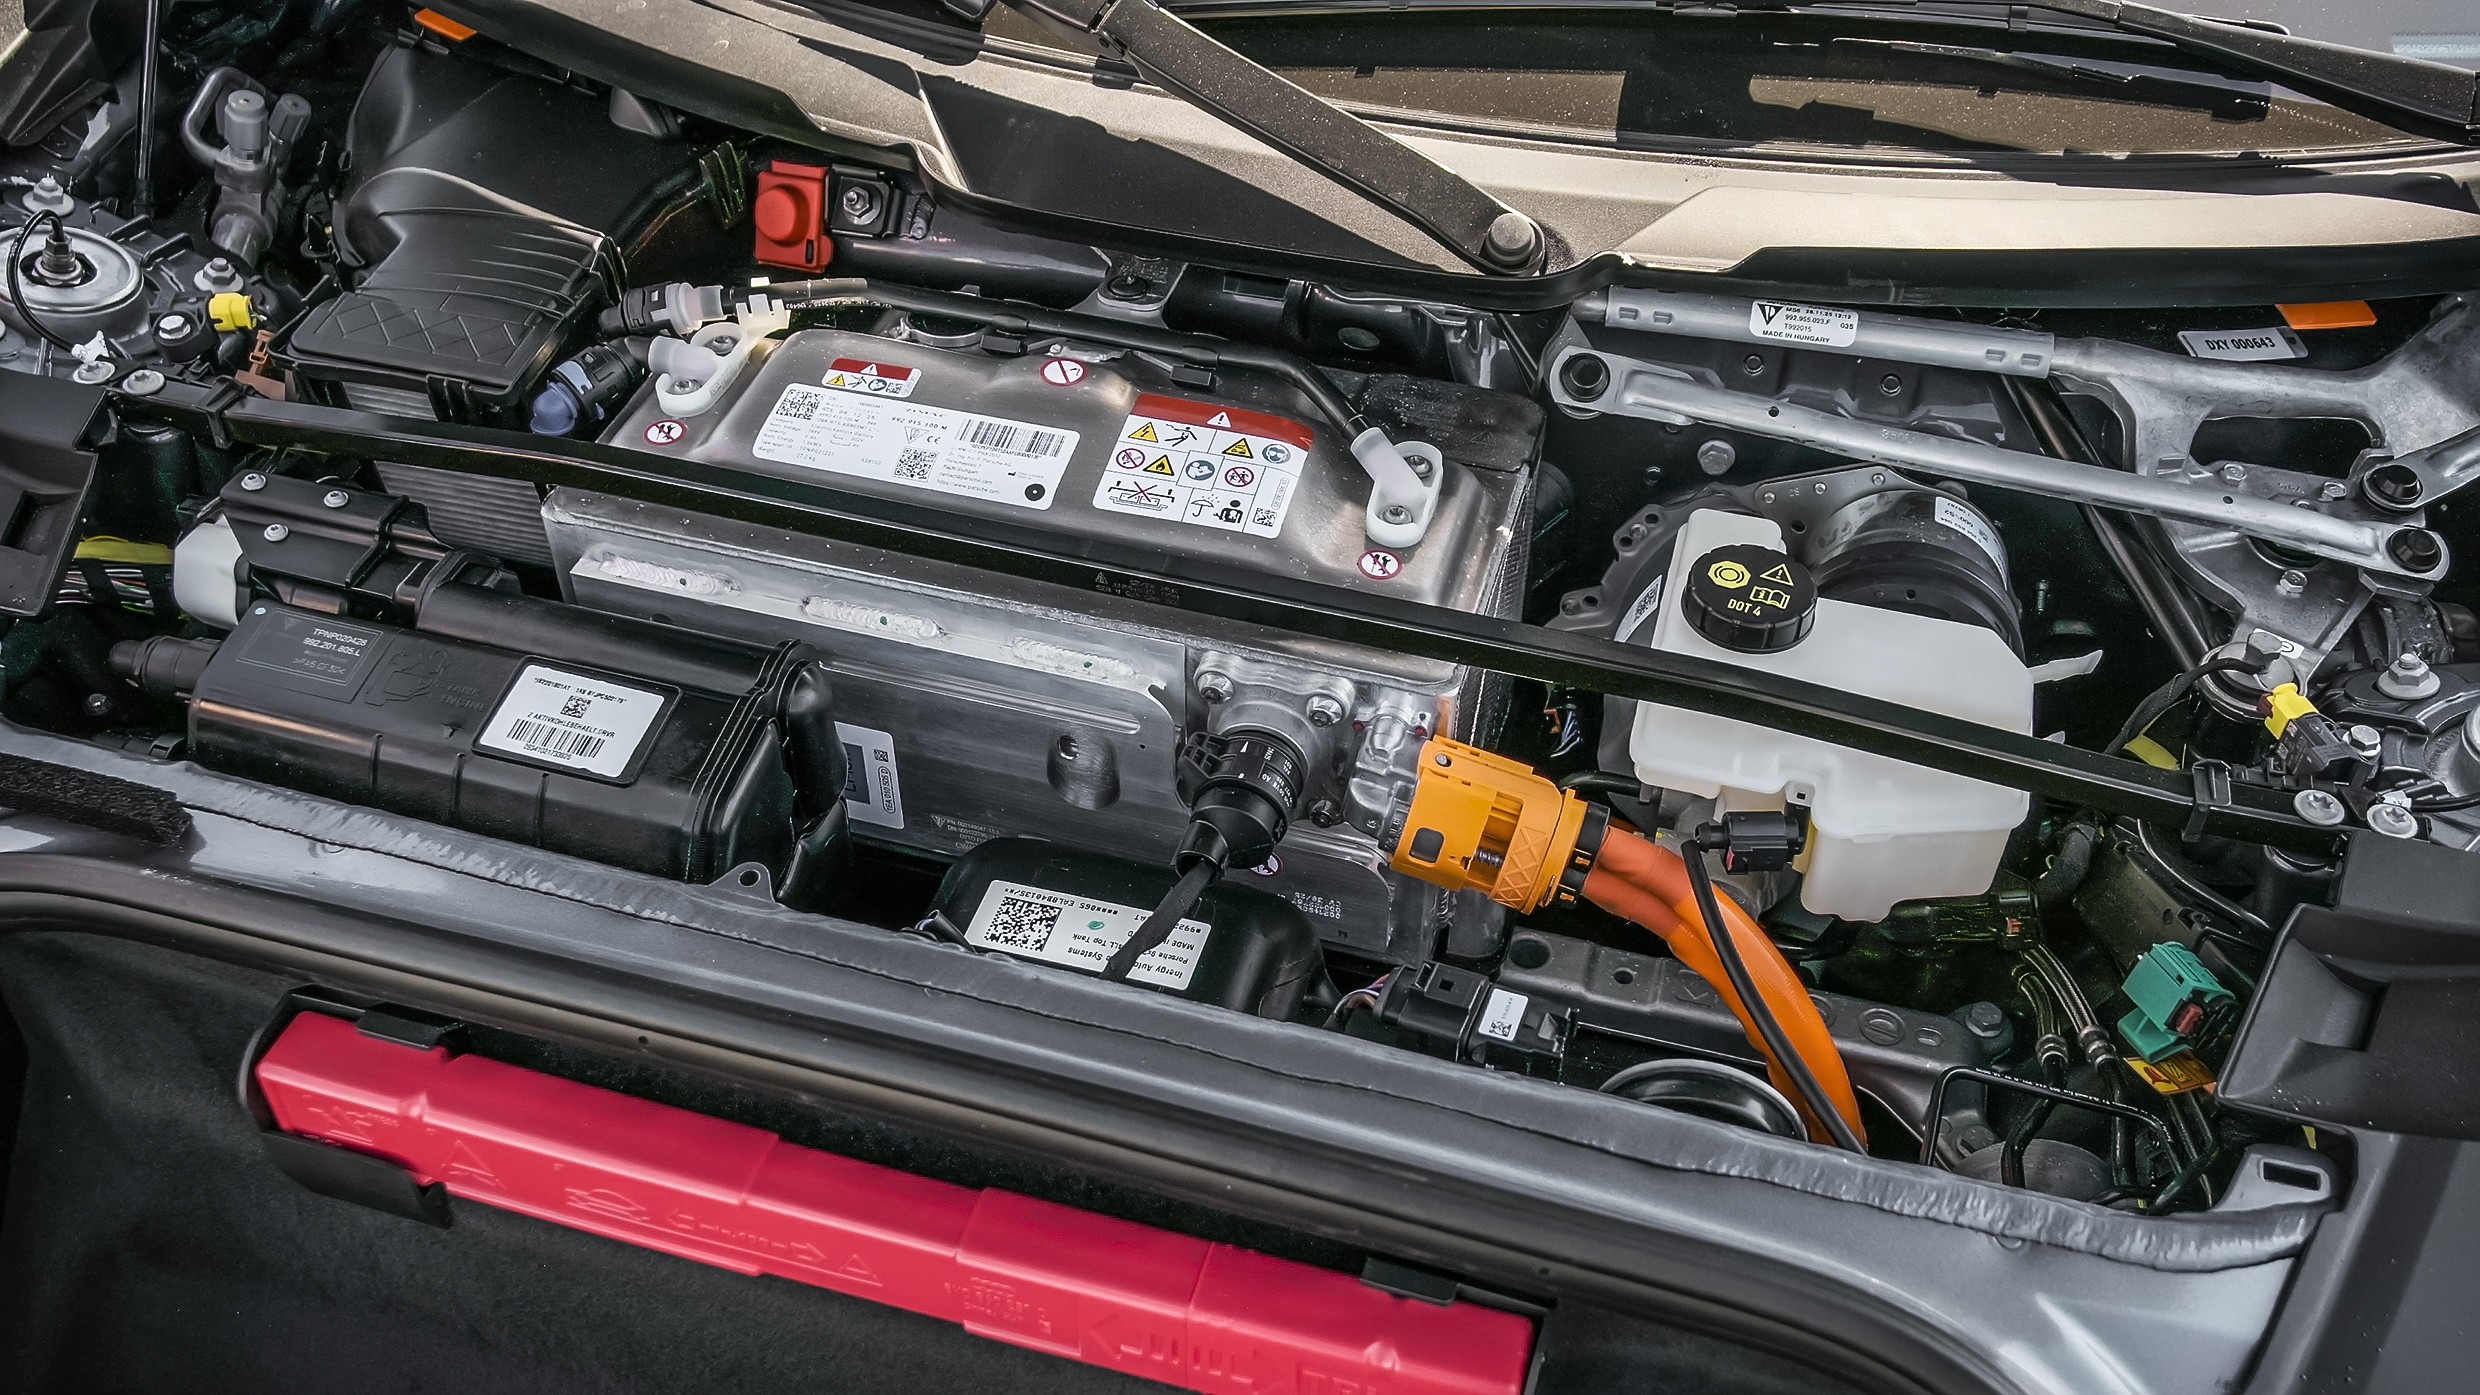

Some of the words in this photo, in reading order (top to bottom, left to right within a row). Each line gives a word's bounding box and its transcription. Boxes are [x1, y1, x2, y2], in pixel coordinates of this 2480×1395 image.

[1793, 333, 1829, 342] HUNGARY
[2205, 339, 2230, 351] DXY
[2231, 336, 2276, 350] 000643
[1728, 599, 1752, 613] DOT
[1752, 606, 1761, 616] 4
[1070, 932, 1091, 943] Tank
[1091, 936, 1107, 946] Top
[1170, 939, 1195, 950] MADE
[1066, 945, 1103, 961] Systems
[1156, 951, 1189, 965] Porsche
[1153, 965, 1183, 979] Inergy
